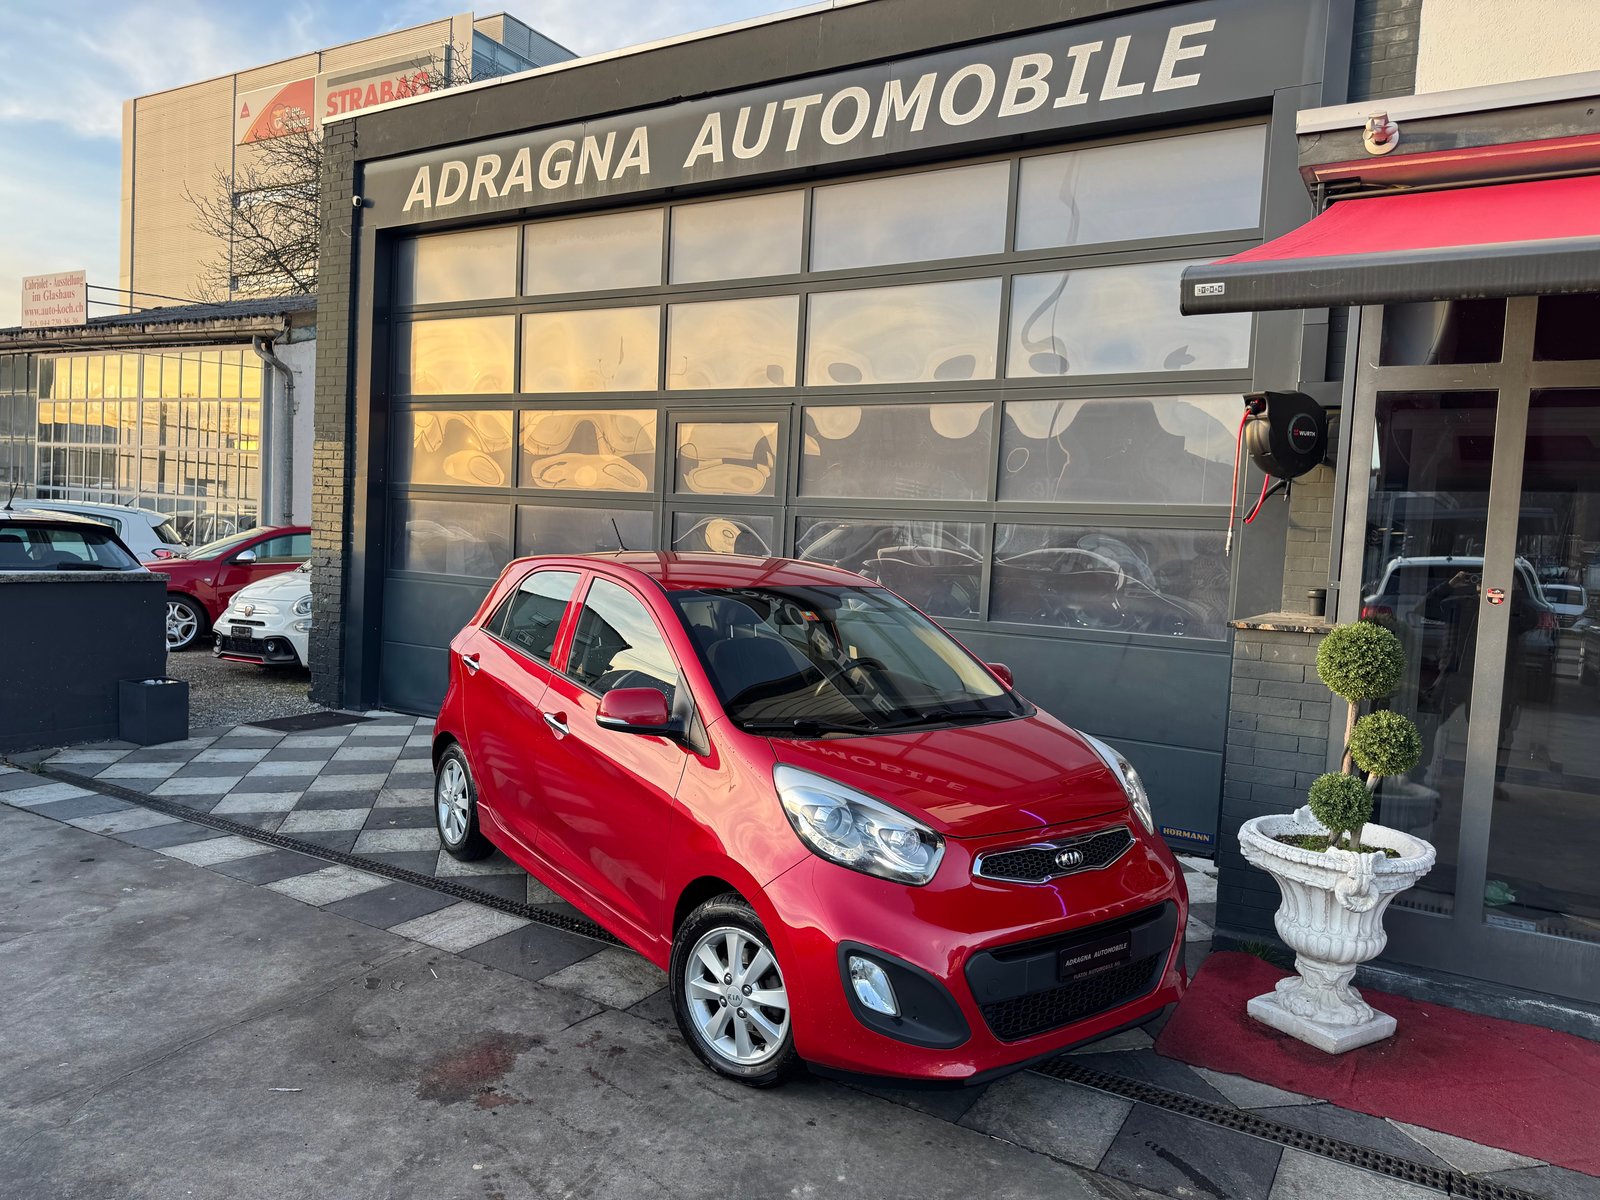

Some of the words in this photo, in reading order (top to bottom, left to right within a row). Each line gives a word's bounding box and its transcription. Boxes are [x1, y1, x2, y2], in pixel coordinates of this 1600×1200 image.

[402, 126, 651, 212] ADRAGNA
[682, 19, 1217, 168] AUTOMOBILE
[32, 292, 41, 302] im
[43, 289, 75, 302] Glashaus
[24, 302, 84, 316] www.auto-koch.ch
[1060, 851, 1080, 866] KIA
[1065, 953, 1092, 967] ADRAGNA
[1093, 942, 1128, 958] AUTOMOBILE
[727, 993, 741, 1001] KIA
